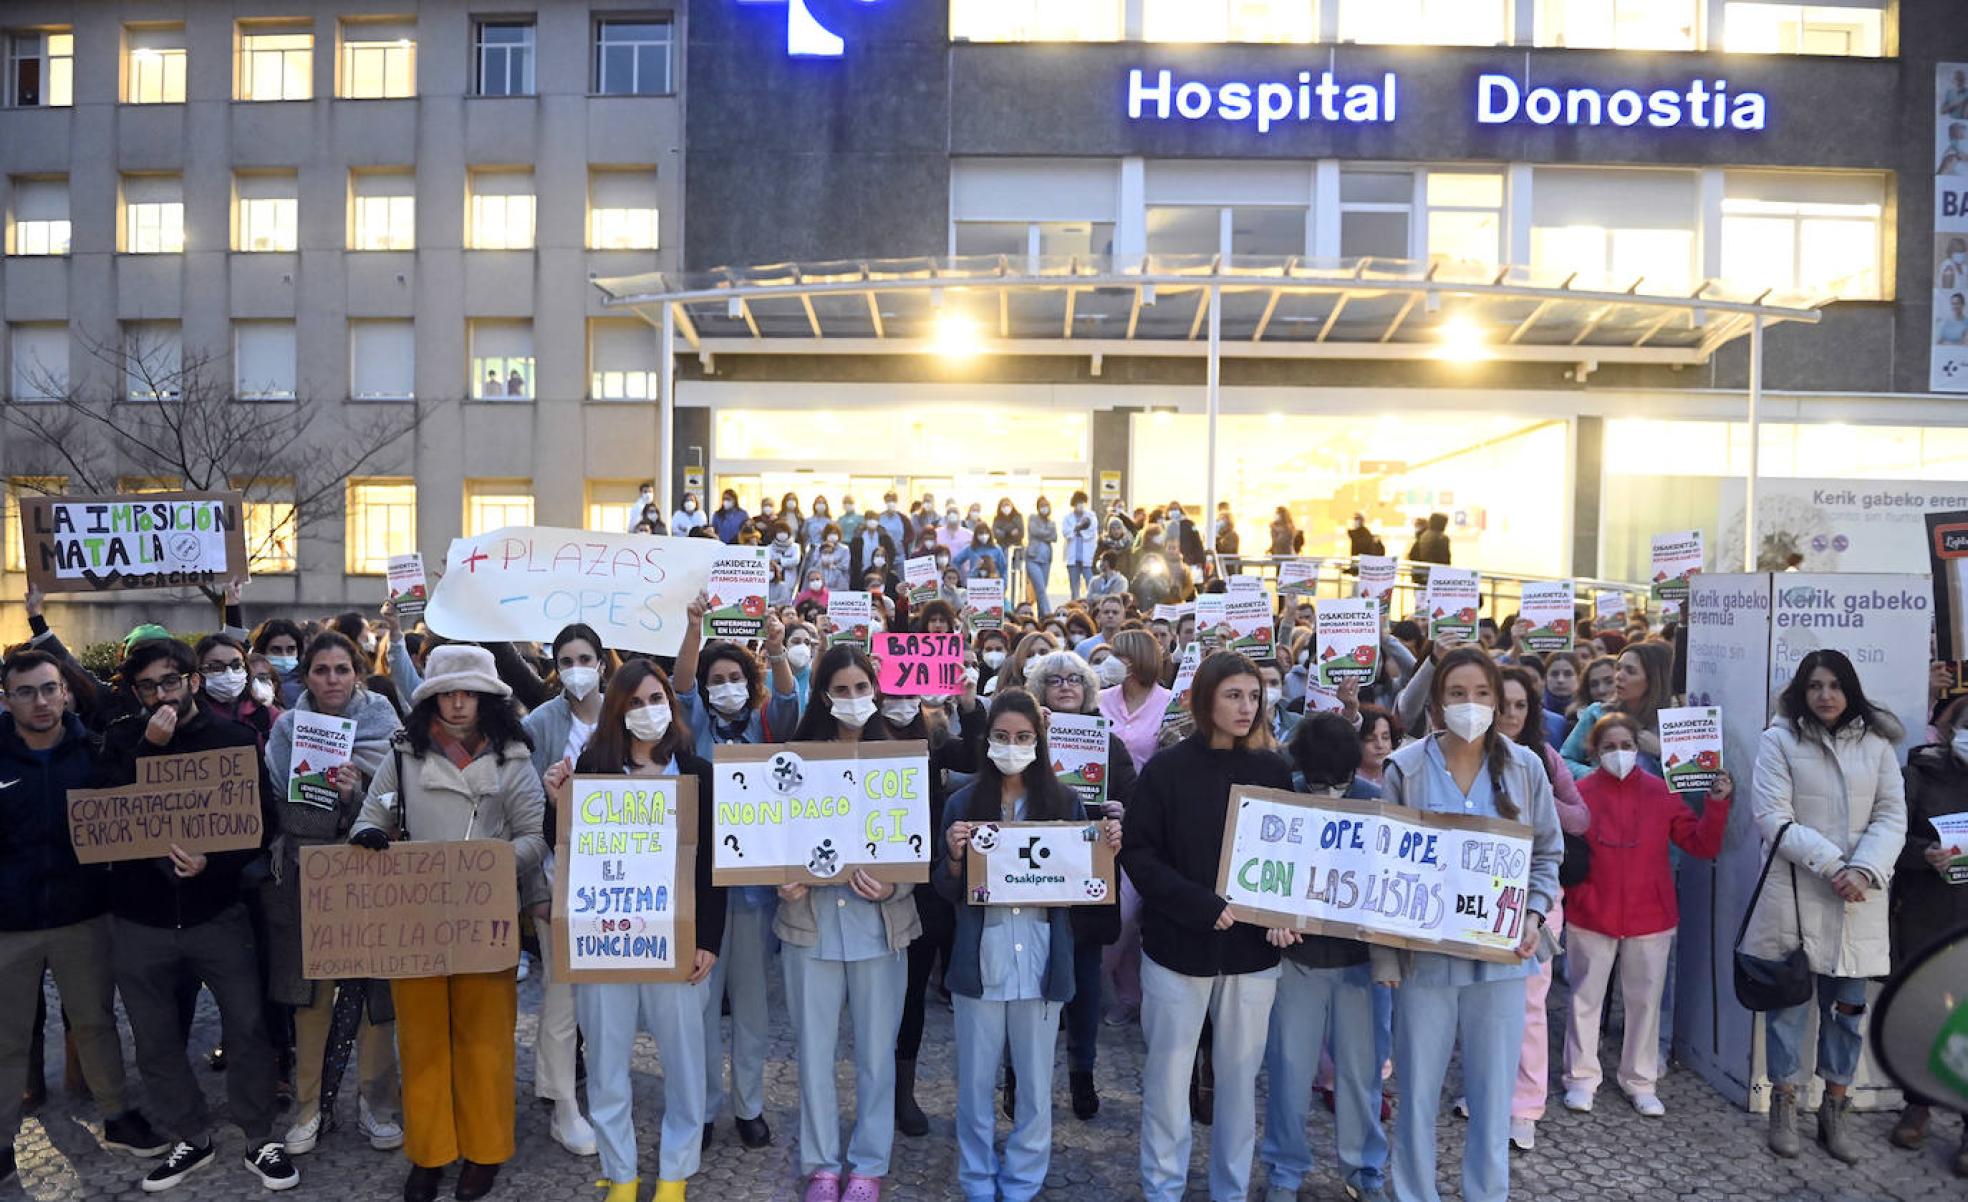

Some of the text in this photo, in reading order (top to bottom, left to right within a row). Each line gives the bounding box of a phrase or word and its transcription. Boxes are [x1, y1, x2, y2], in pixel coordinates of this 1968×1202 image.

[1128, 70, 1766, 132] Hospital Donostia
[1813, 490, 1856, 505] Kerik
[1861, 491, 1925, 509] gabeko
[33, 500, 235, 533] LA IMPOSICIÓN
[40, 537, 131, 571] MATA
[139, 534, 164, 563] LA
[502, 538, 666, 583] PLAZAS
[82, 565, 216, 590] VOCACIÓN
[543, 590, 664, 632] OPES
[1692, 589, 1719, 608] Kerik
[1723, 590, 1768, 612] gabeko
[1778, 588, 1927, 613] Kerik gabeko
[1691, 612, 1734, 626] eremua
[1777, 612, 1864, 628] eremua
[887, 635, 960, 656] BASTA
[894, 662, 929, 688] YA
[146, 753, 243, 784] LISTAS DE
[863, 767, 919, 800] COE
[71, 790, 212, 822] CONTRATACIÓN
[718, 795, 850, 825] NON DAGO
[73, 812, 260, 847] ERROR 404 NOT FOUND
[865, 808, 909, 843] GI
[578, 831, 663, 855] MENTE
[1260, 814, 1304, 844] DE
[1320, 819, 1364, 851] OPE
[1376, 824, 1391, 854] A
[1461, 839, 1526, 879] PERO
[306, 849, 495, 881] OSAKIDETZA NO
[602, 859, 625, 882] EL
[1004, 873, 1066, 886] Osakipresa
[307, 884, 333, 912] ME
[465, 881, 492, 905] YO
[574, 885, 668, 914] SISTEMA
[1237, 857, 1525, 938] CON LAS LISTAS DEL 14
[308, 923, 332, 951] YA
[341, 921, 388, 949] HICE
[399, 921, 425, 948] LA
[576, 933, 667, 961] FUNCIONA
